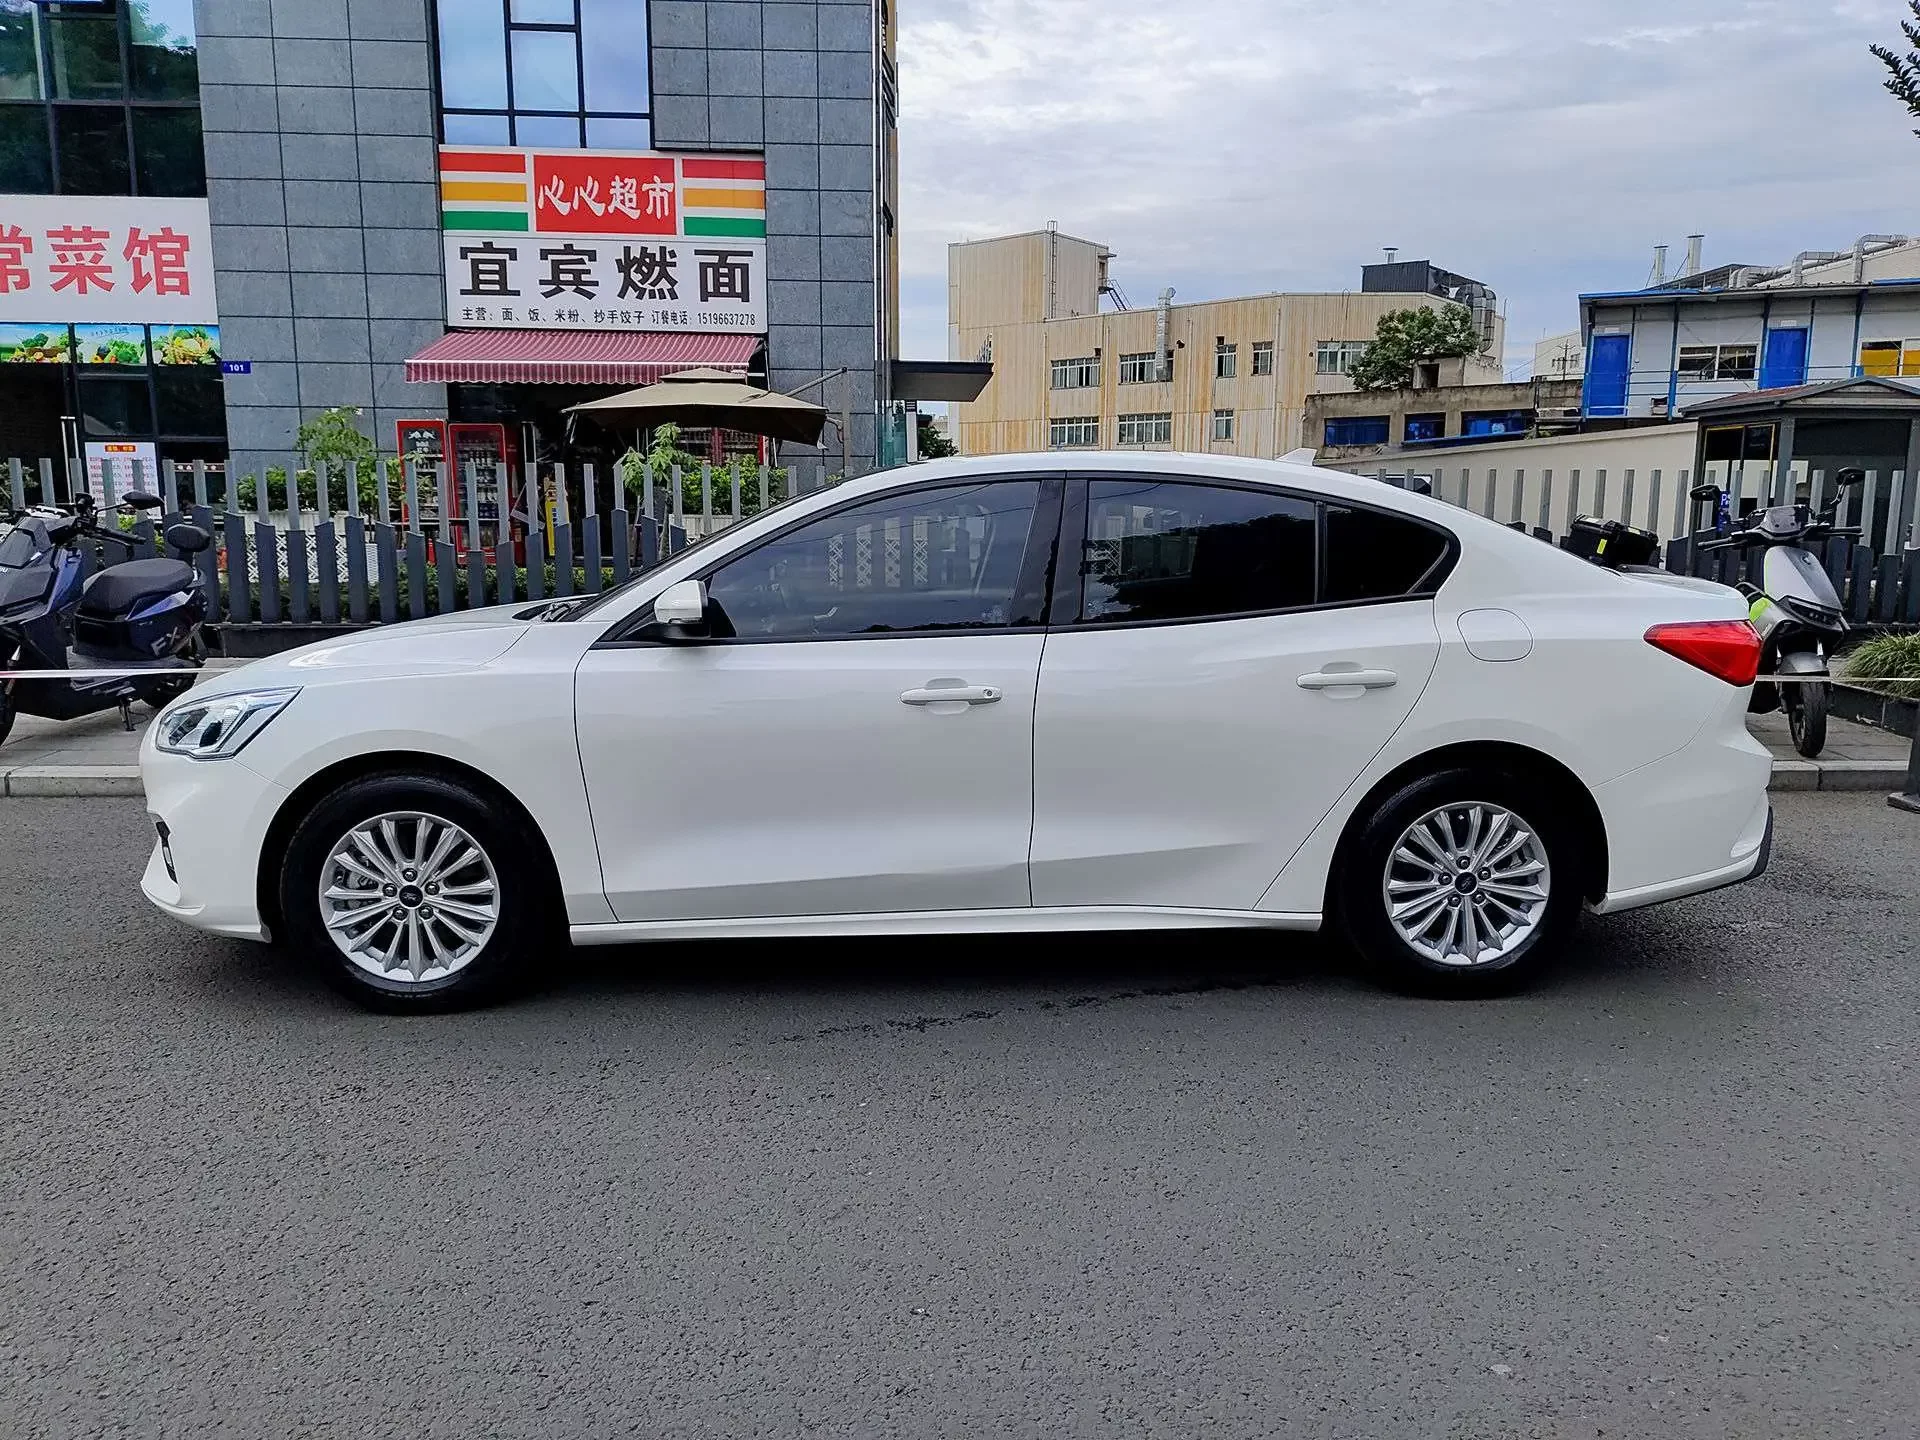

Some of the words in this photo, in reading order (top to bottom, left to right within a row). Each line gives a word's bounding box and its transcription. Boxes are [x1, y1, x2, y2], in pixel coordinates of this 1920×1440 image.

[537, 174, 675, 220] 心心超市
[458, 241, 754, 303] 宜宾燃面
[697, 312, 756, 326] 15196637278
[229, 363, 245, 372] 101
